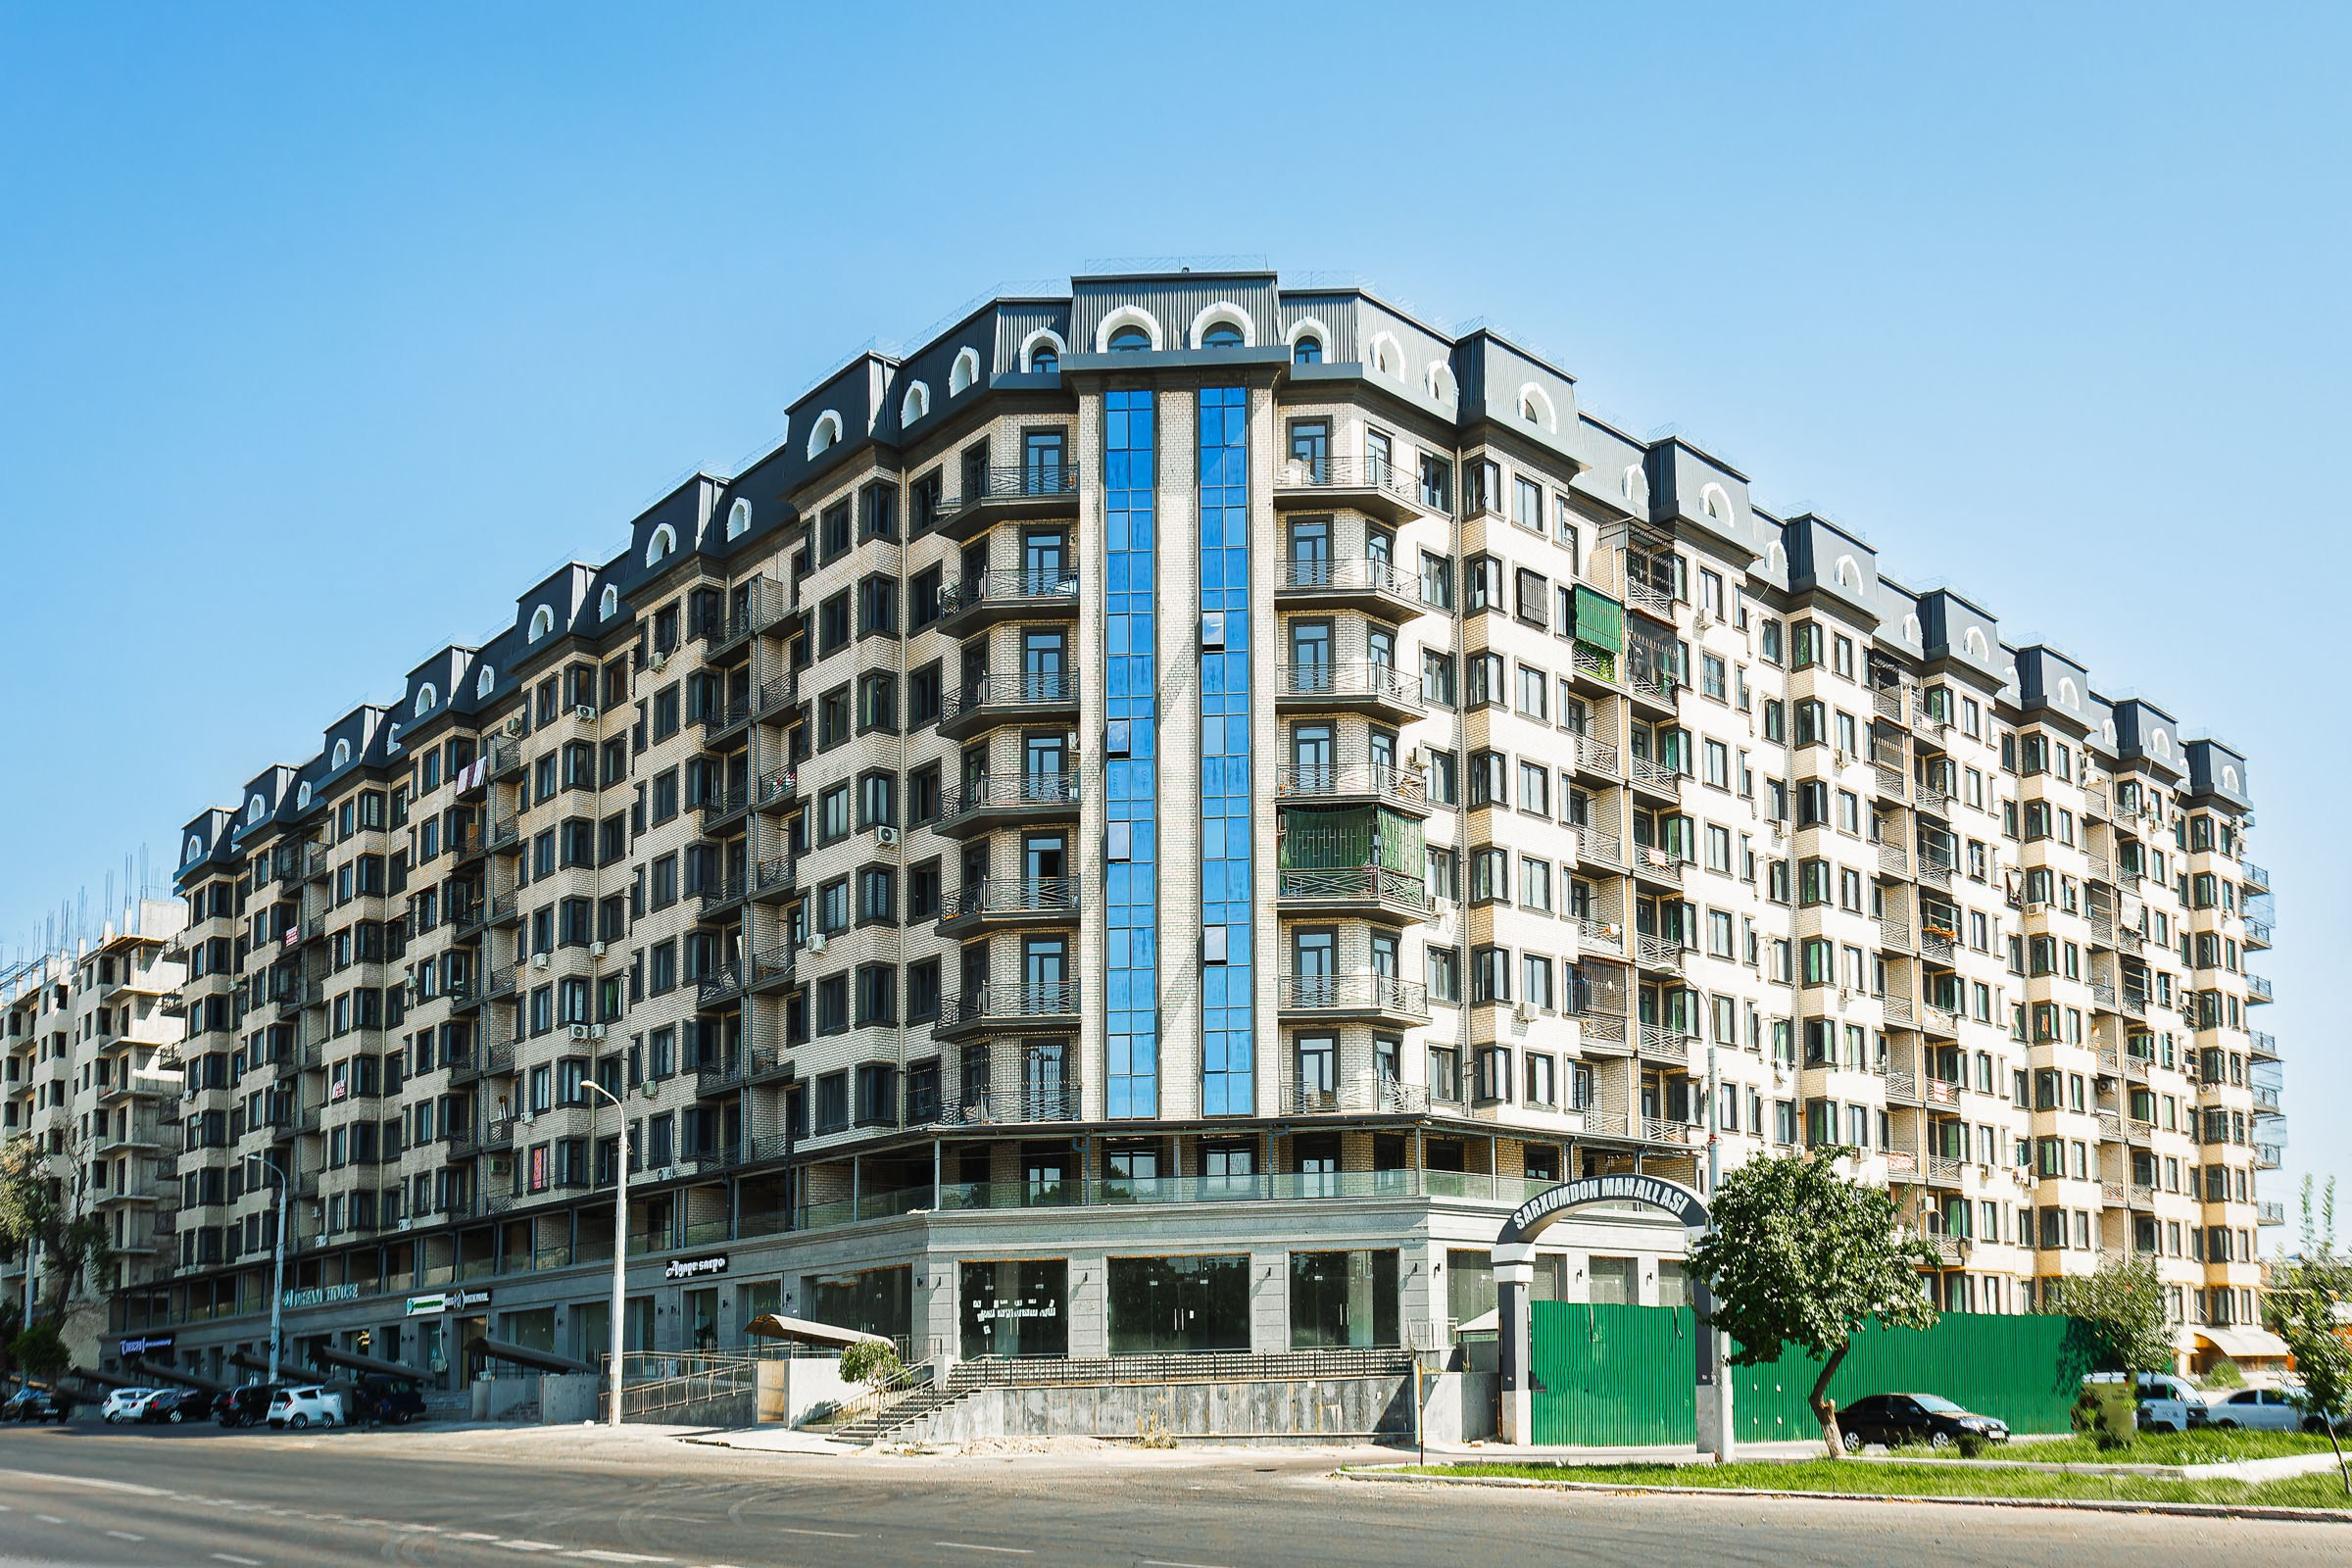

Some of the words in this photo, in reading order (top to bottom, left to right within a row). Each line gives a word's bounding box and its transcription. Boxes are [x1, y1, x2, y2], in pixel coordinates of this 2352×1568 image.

[1513, 1179, 1599, 1230] SARXUMDON
[1601, 1177, 1690, 1216] MAHALLASI
[294, 1289, 323, 1307] DREAM
[325, 1283, 359, 1302] HOUSE
